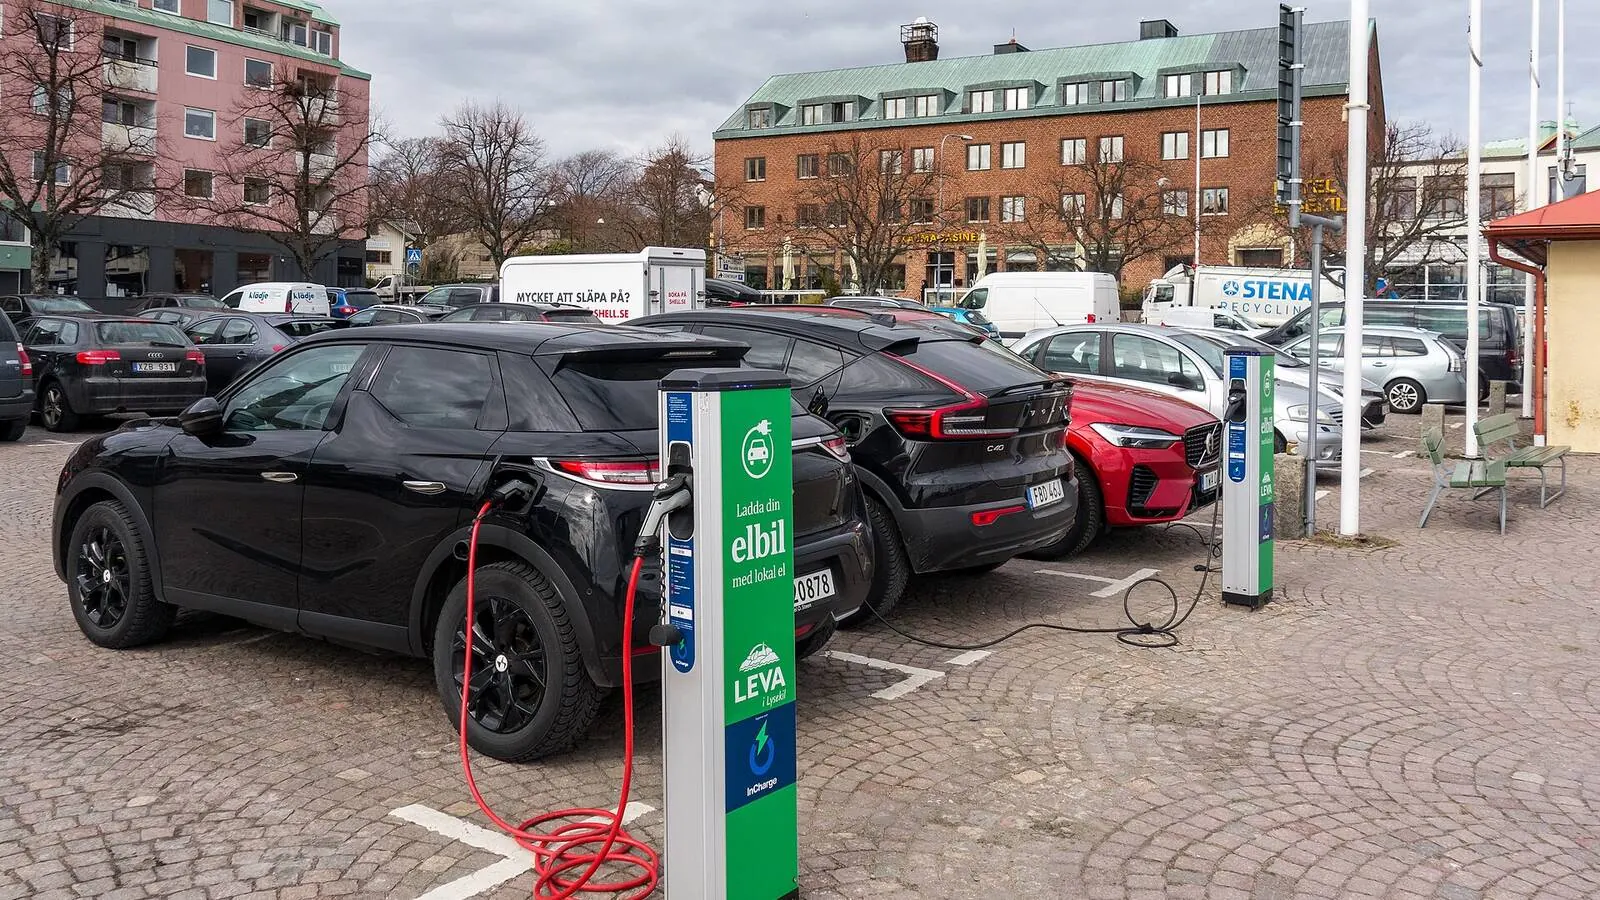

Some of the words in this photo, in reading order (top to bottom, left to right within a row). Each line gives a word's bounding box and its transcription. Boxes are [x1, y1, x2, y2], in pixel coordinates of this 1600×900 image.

[516, 292, 554, 303] MYCKET
[557, 292, 573, 302] ATT
[576, 289, 607, 303] SLÄPA
[610, 289, 631, 303] PÅ?
[1243, 280, 1312, 301] STENA
[594, 309, 629, 318] SHELL.SE
[987, 444, 1004, 452] C40
[1033, 485, 1048, 505] FBD
[736, 500, 764, 518] Ladda
[766, 498, 780, 512] din
[731, 519, 786, 564] elbil
[732, 569, 753, 588] med
[754, 564, 776, 583] lokal
[778, 562, 786, 577] el
[734, 666, 786, 704] LEVA
[762, 697, 766, 707] i
[766, 688, 787, 708] Lysekil
[746, 777, 778, 797] InCharge
